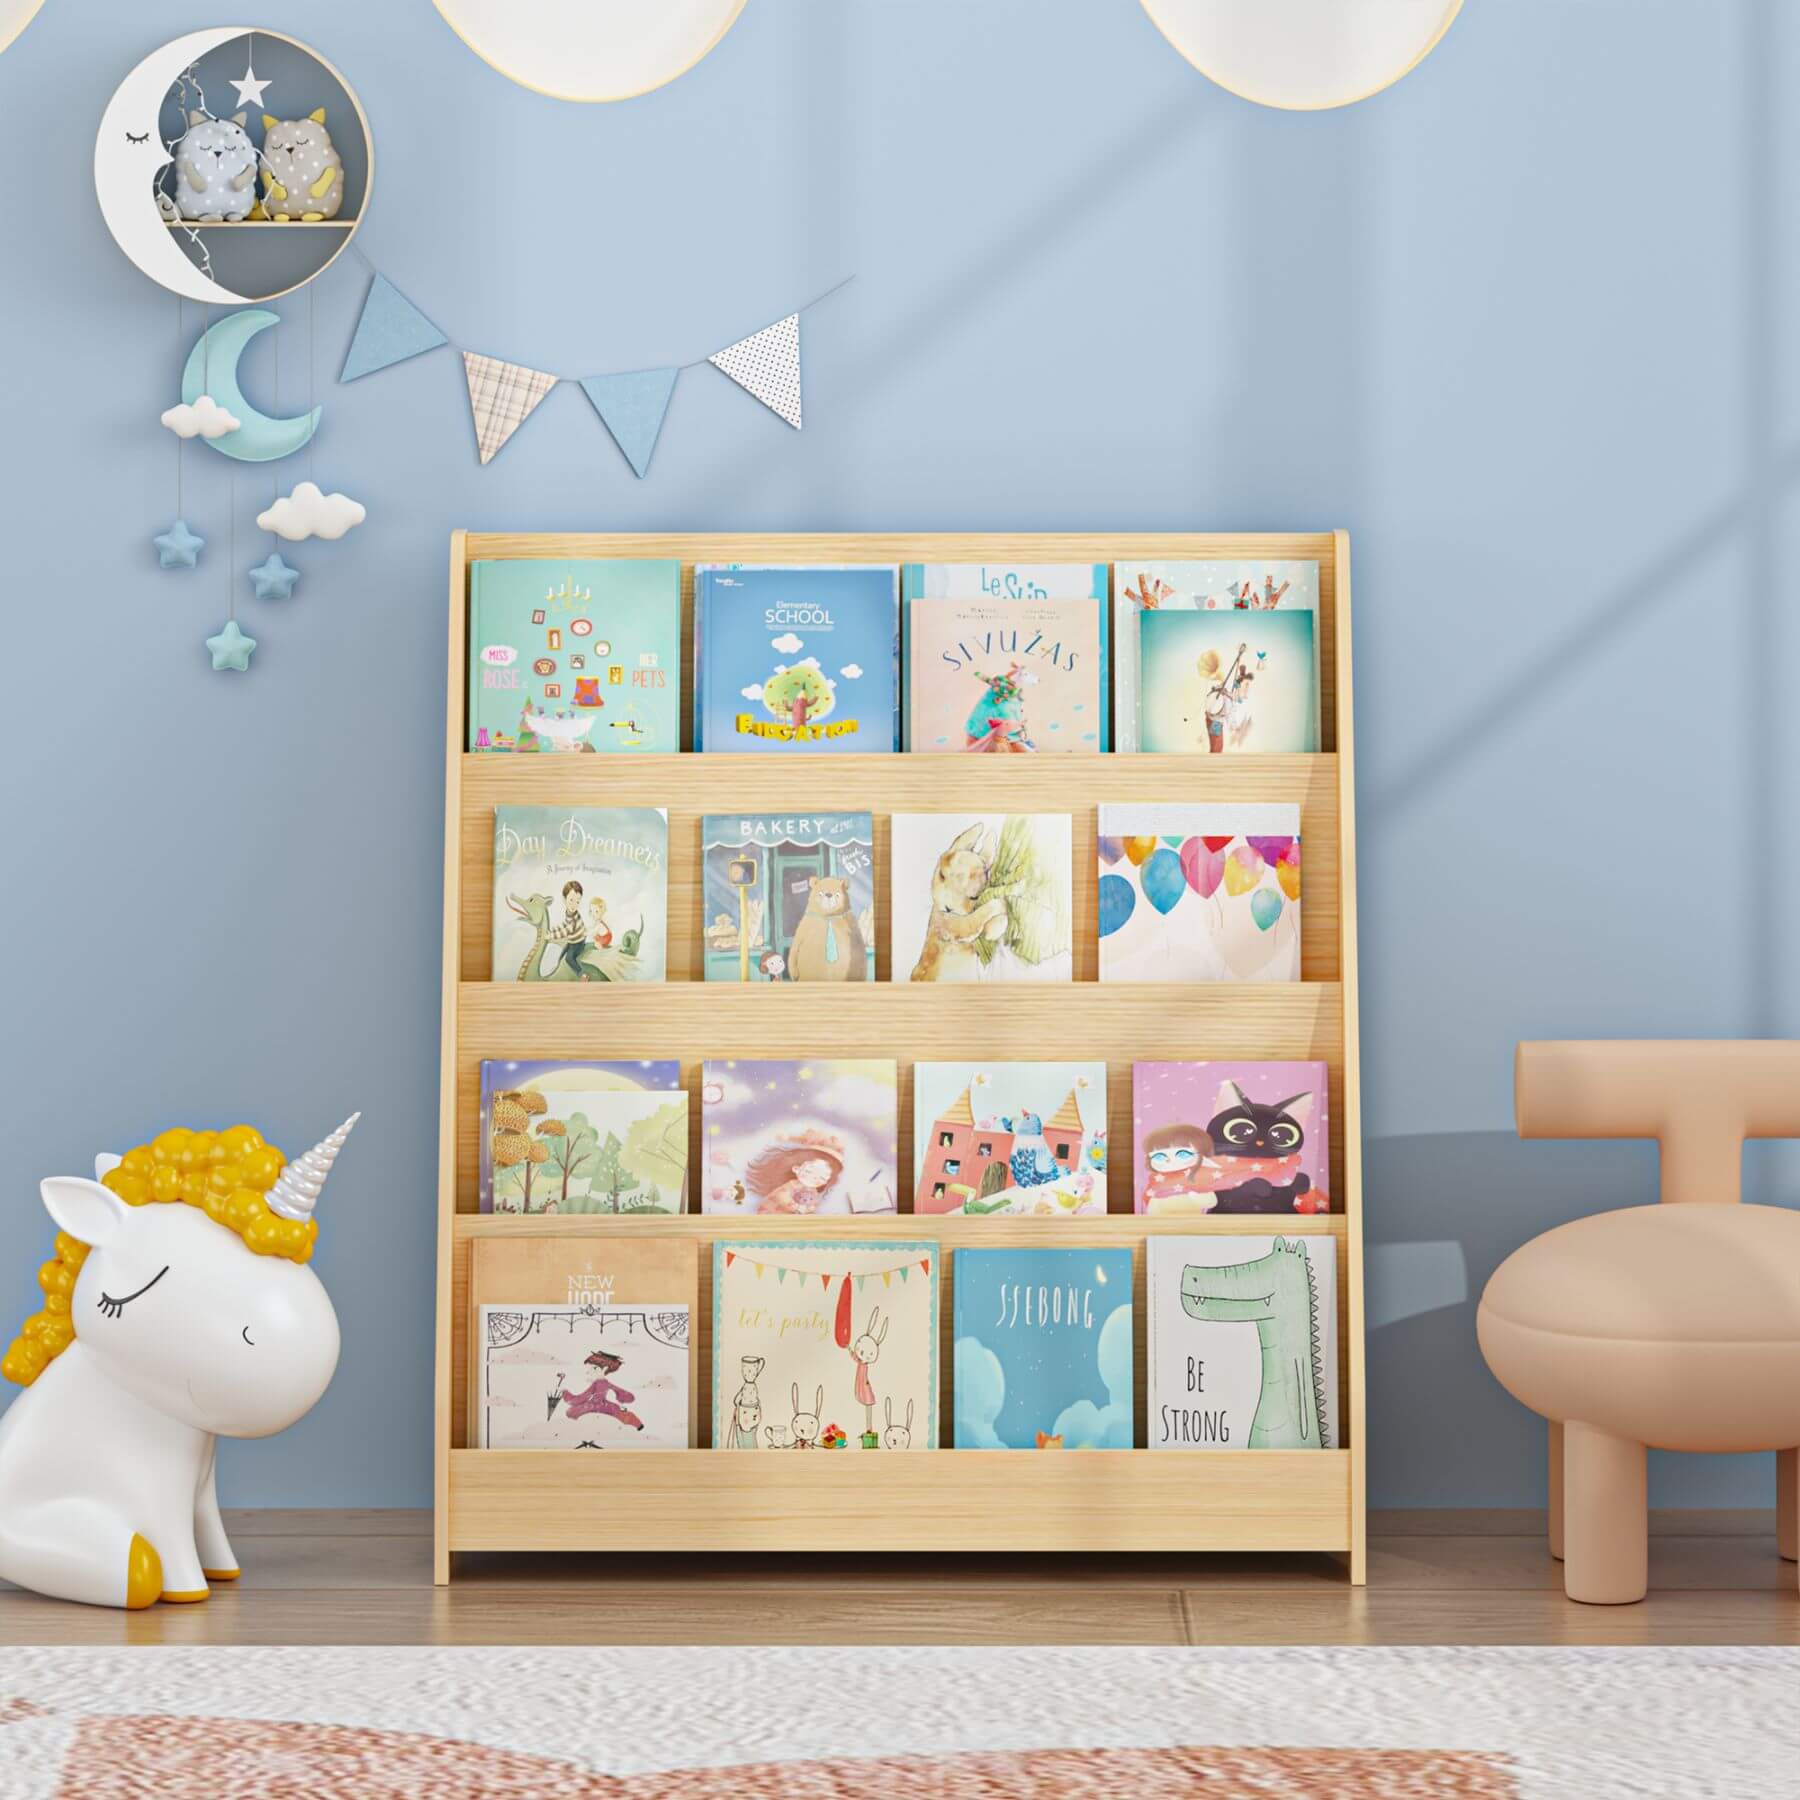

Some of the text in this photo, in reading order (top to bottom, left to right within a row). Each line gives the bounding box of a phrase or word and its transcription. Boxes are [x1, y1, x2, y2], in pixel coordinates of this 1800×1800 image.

[982, 567, 1001, 596] Le
[775, 600, 821, 610] Elementary
[765, 609, 834, 624] SCHOOL
[488, 649, 508, 662] MISS
[483, 669, 521, 689] ROSE
[632, 671, 666, 689] PETS
[740, 819, 825, 836] BAKERY
[496, 815, 660, 872] Day Dreamers
[567, 1274, 616, 1289] NEW
[1187, 1355, 1205, 1392] BE
[1161, 1404, 1230, 1442] STRONG
